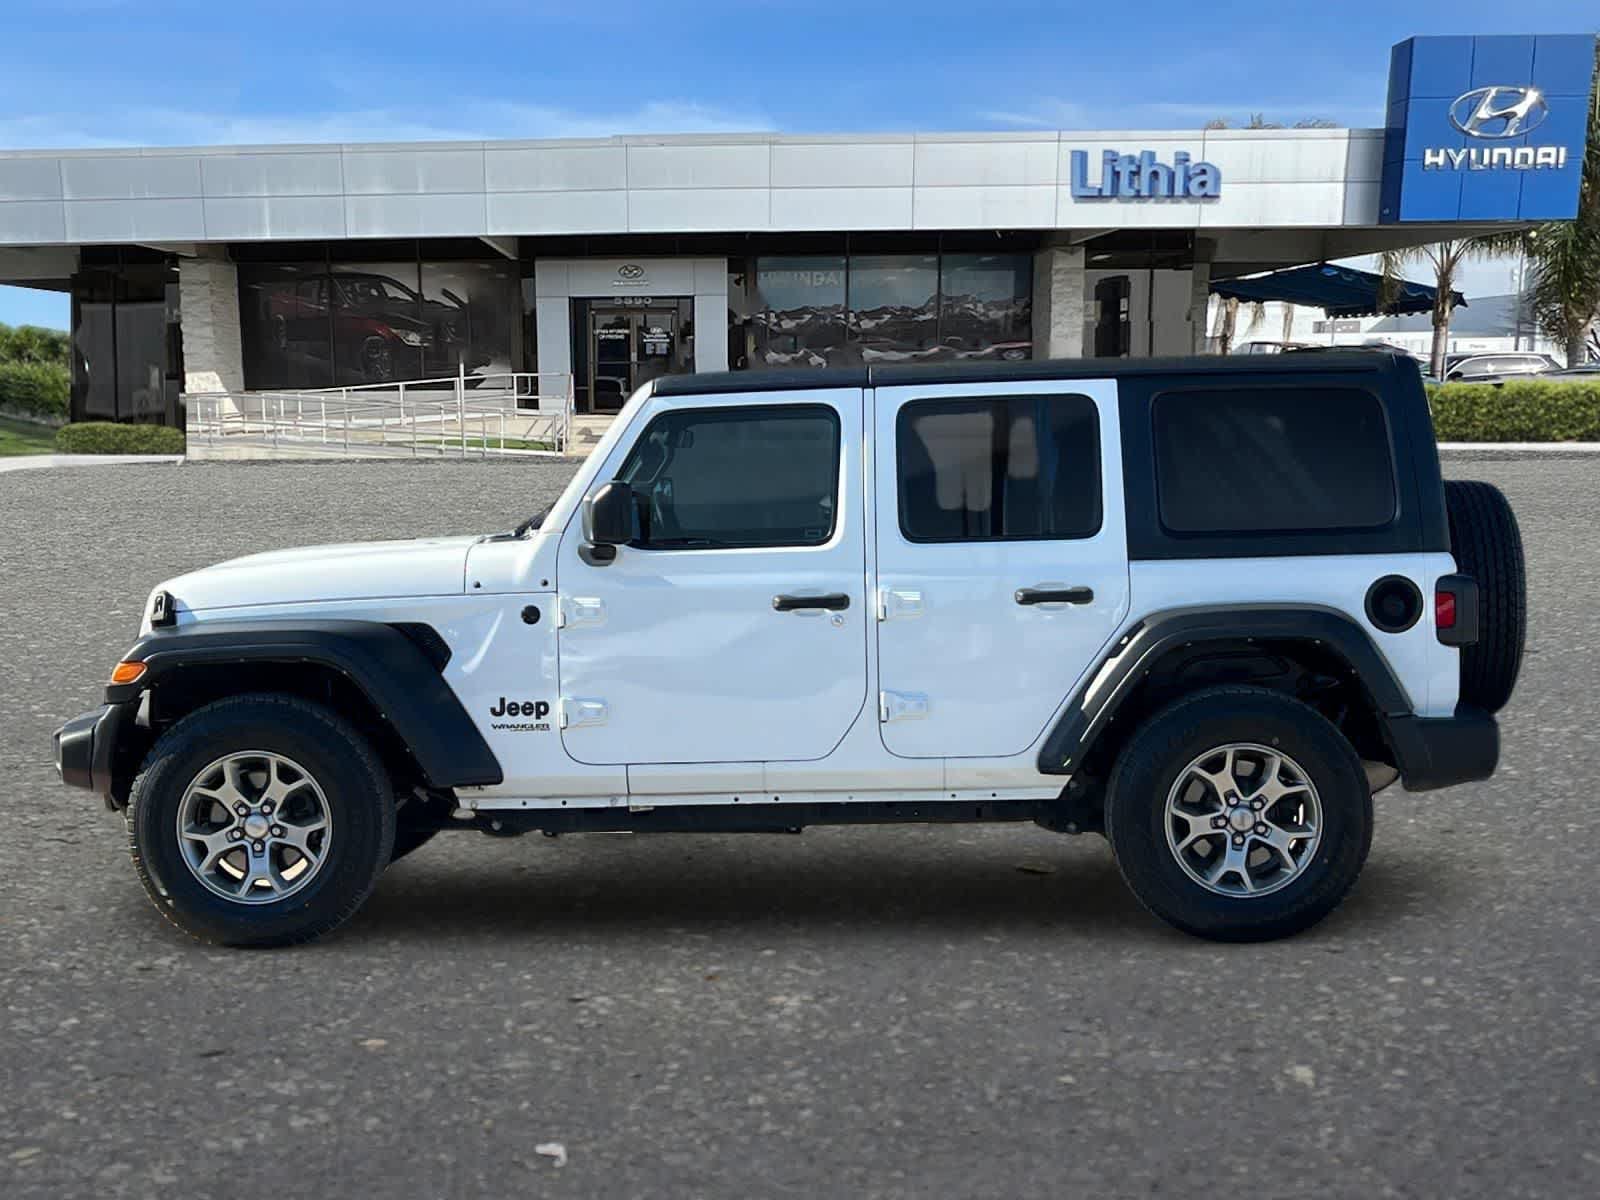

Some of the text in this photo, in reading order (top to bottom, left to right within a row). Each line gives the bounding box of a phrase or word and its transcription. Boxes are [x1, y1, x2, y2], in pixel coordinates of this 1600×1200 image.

[1423, 147, 1567, 170] HYUNDAI
[1071, 150, 1221, 199] Lithia
[490, 697, 550, 720] Jeep
